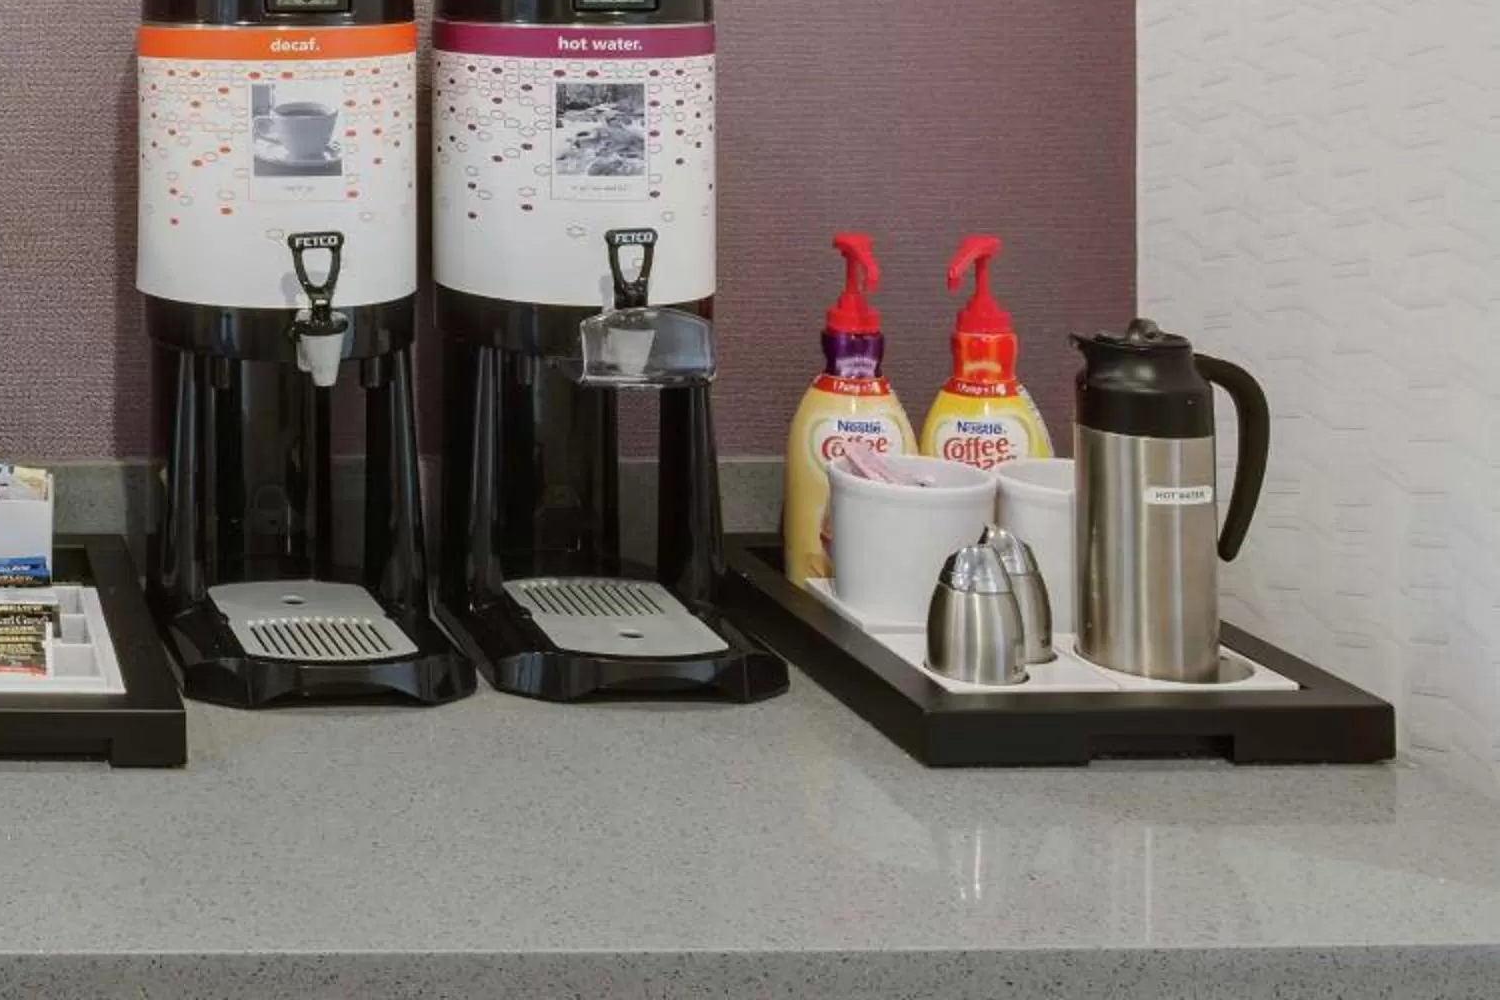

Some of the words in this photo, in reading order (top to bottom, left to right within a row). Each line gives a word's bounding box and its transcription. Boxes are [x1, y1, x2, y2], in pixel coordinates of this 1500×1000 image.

[270, 37, 320, 52] decaf.
[558, 36, 587, 50] hot
[591, 37, 643, 51] water.
[295, 235, 338, 248] FETCO
[615, 231, 653, 243] FETCO
